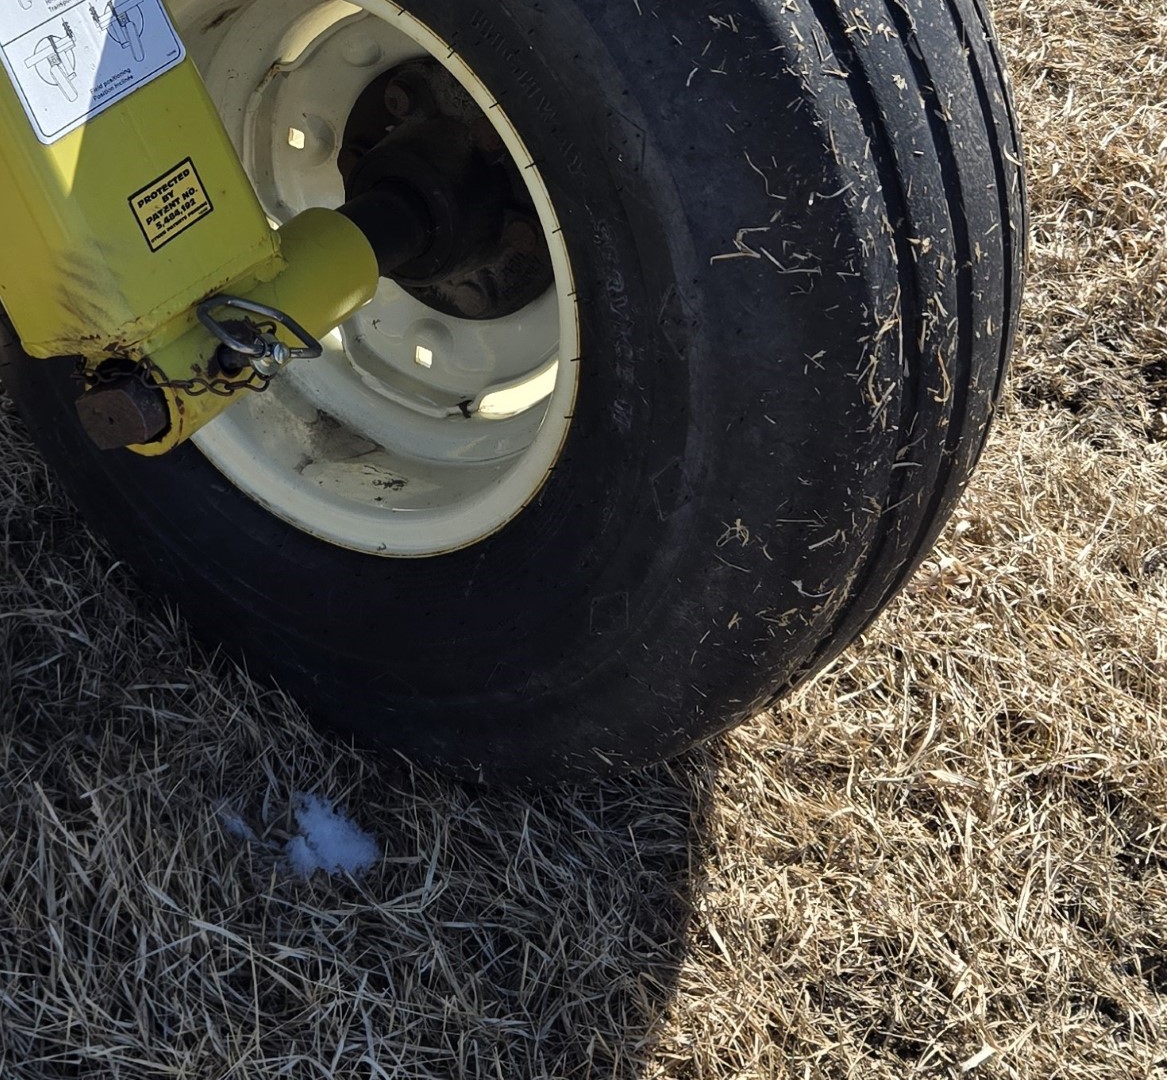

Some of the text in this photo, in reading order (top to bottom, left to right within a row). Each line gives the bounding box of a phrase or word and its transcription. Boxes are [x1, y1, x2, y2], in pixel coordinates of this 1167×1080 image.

[102, 66, 131, 87] positioning
[137, 169, 190, 208] PROTECTED
[162, 190, 174, 203] BY
[146, 187, 198, 225] PATENT NO.
